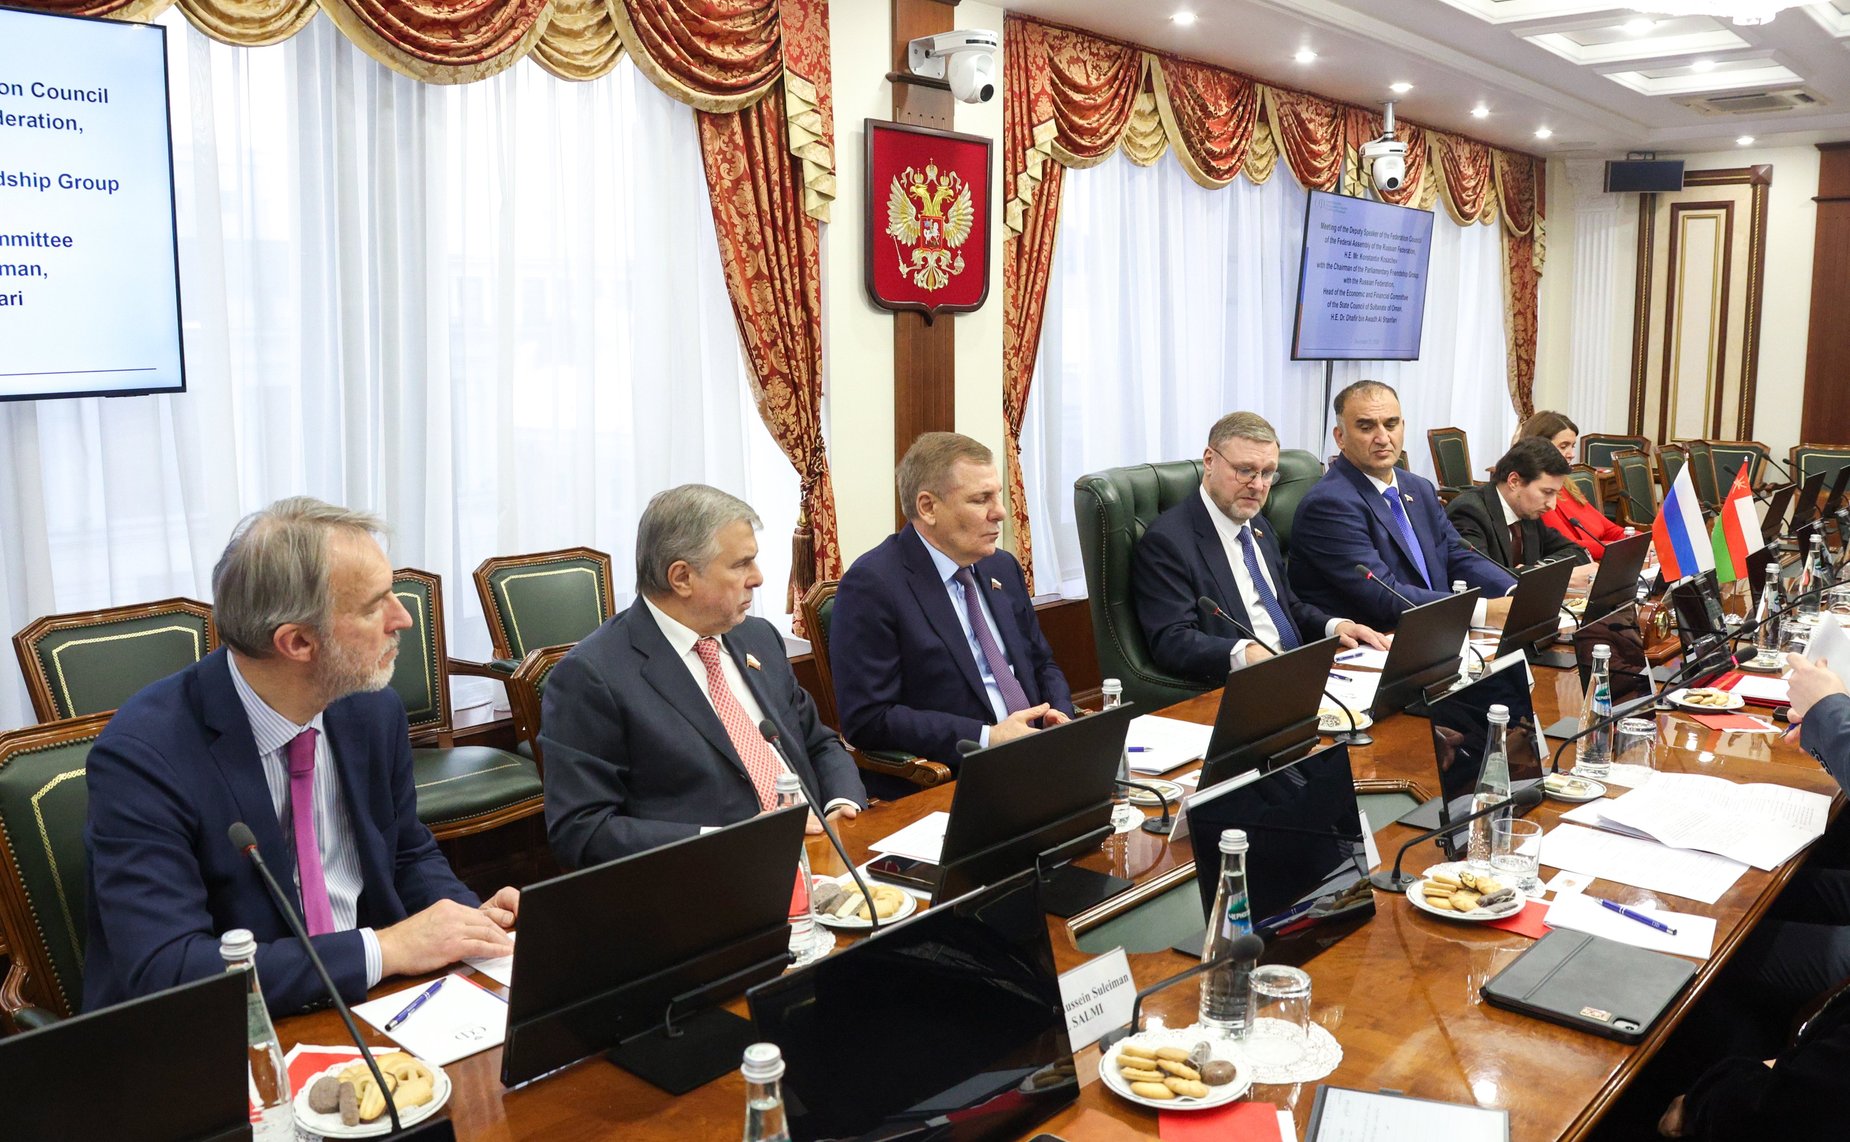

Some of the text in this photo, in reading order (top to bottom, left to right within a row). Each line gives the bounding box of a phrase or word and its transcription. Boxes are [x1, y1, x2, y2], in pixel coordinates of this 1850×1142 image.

[31, 82, 109, 103] Council
[58, 173, 119, 195] Group
[1321, 222, 1337, 233] Meeting
[1350, 226, 1363, 236] Deputy
[1337, 238, 1351, 246] Federal
[1352, 239, 1370, 249] Assembly
[1383, 244, 1397, 252] Russian
[1334, 263, 1352, 271] Chairman
[1365, 267, 1389, 276] Parliamentary
[1359, 278, 1374, 286] Russian
[1065, 974, 1129, 1012] ussein Suleiman
[1071, 1003, 1104, 1028] SALMI
